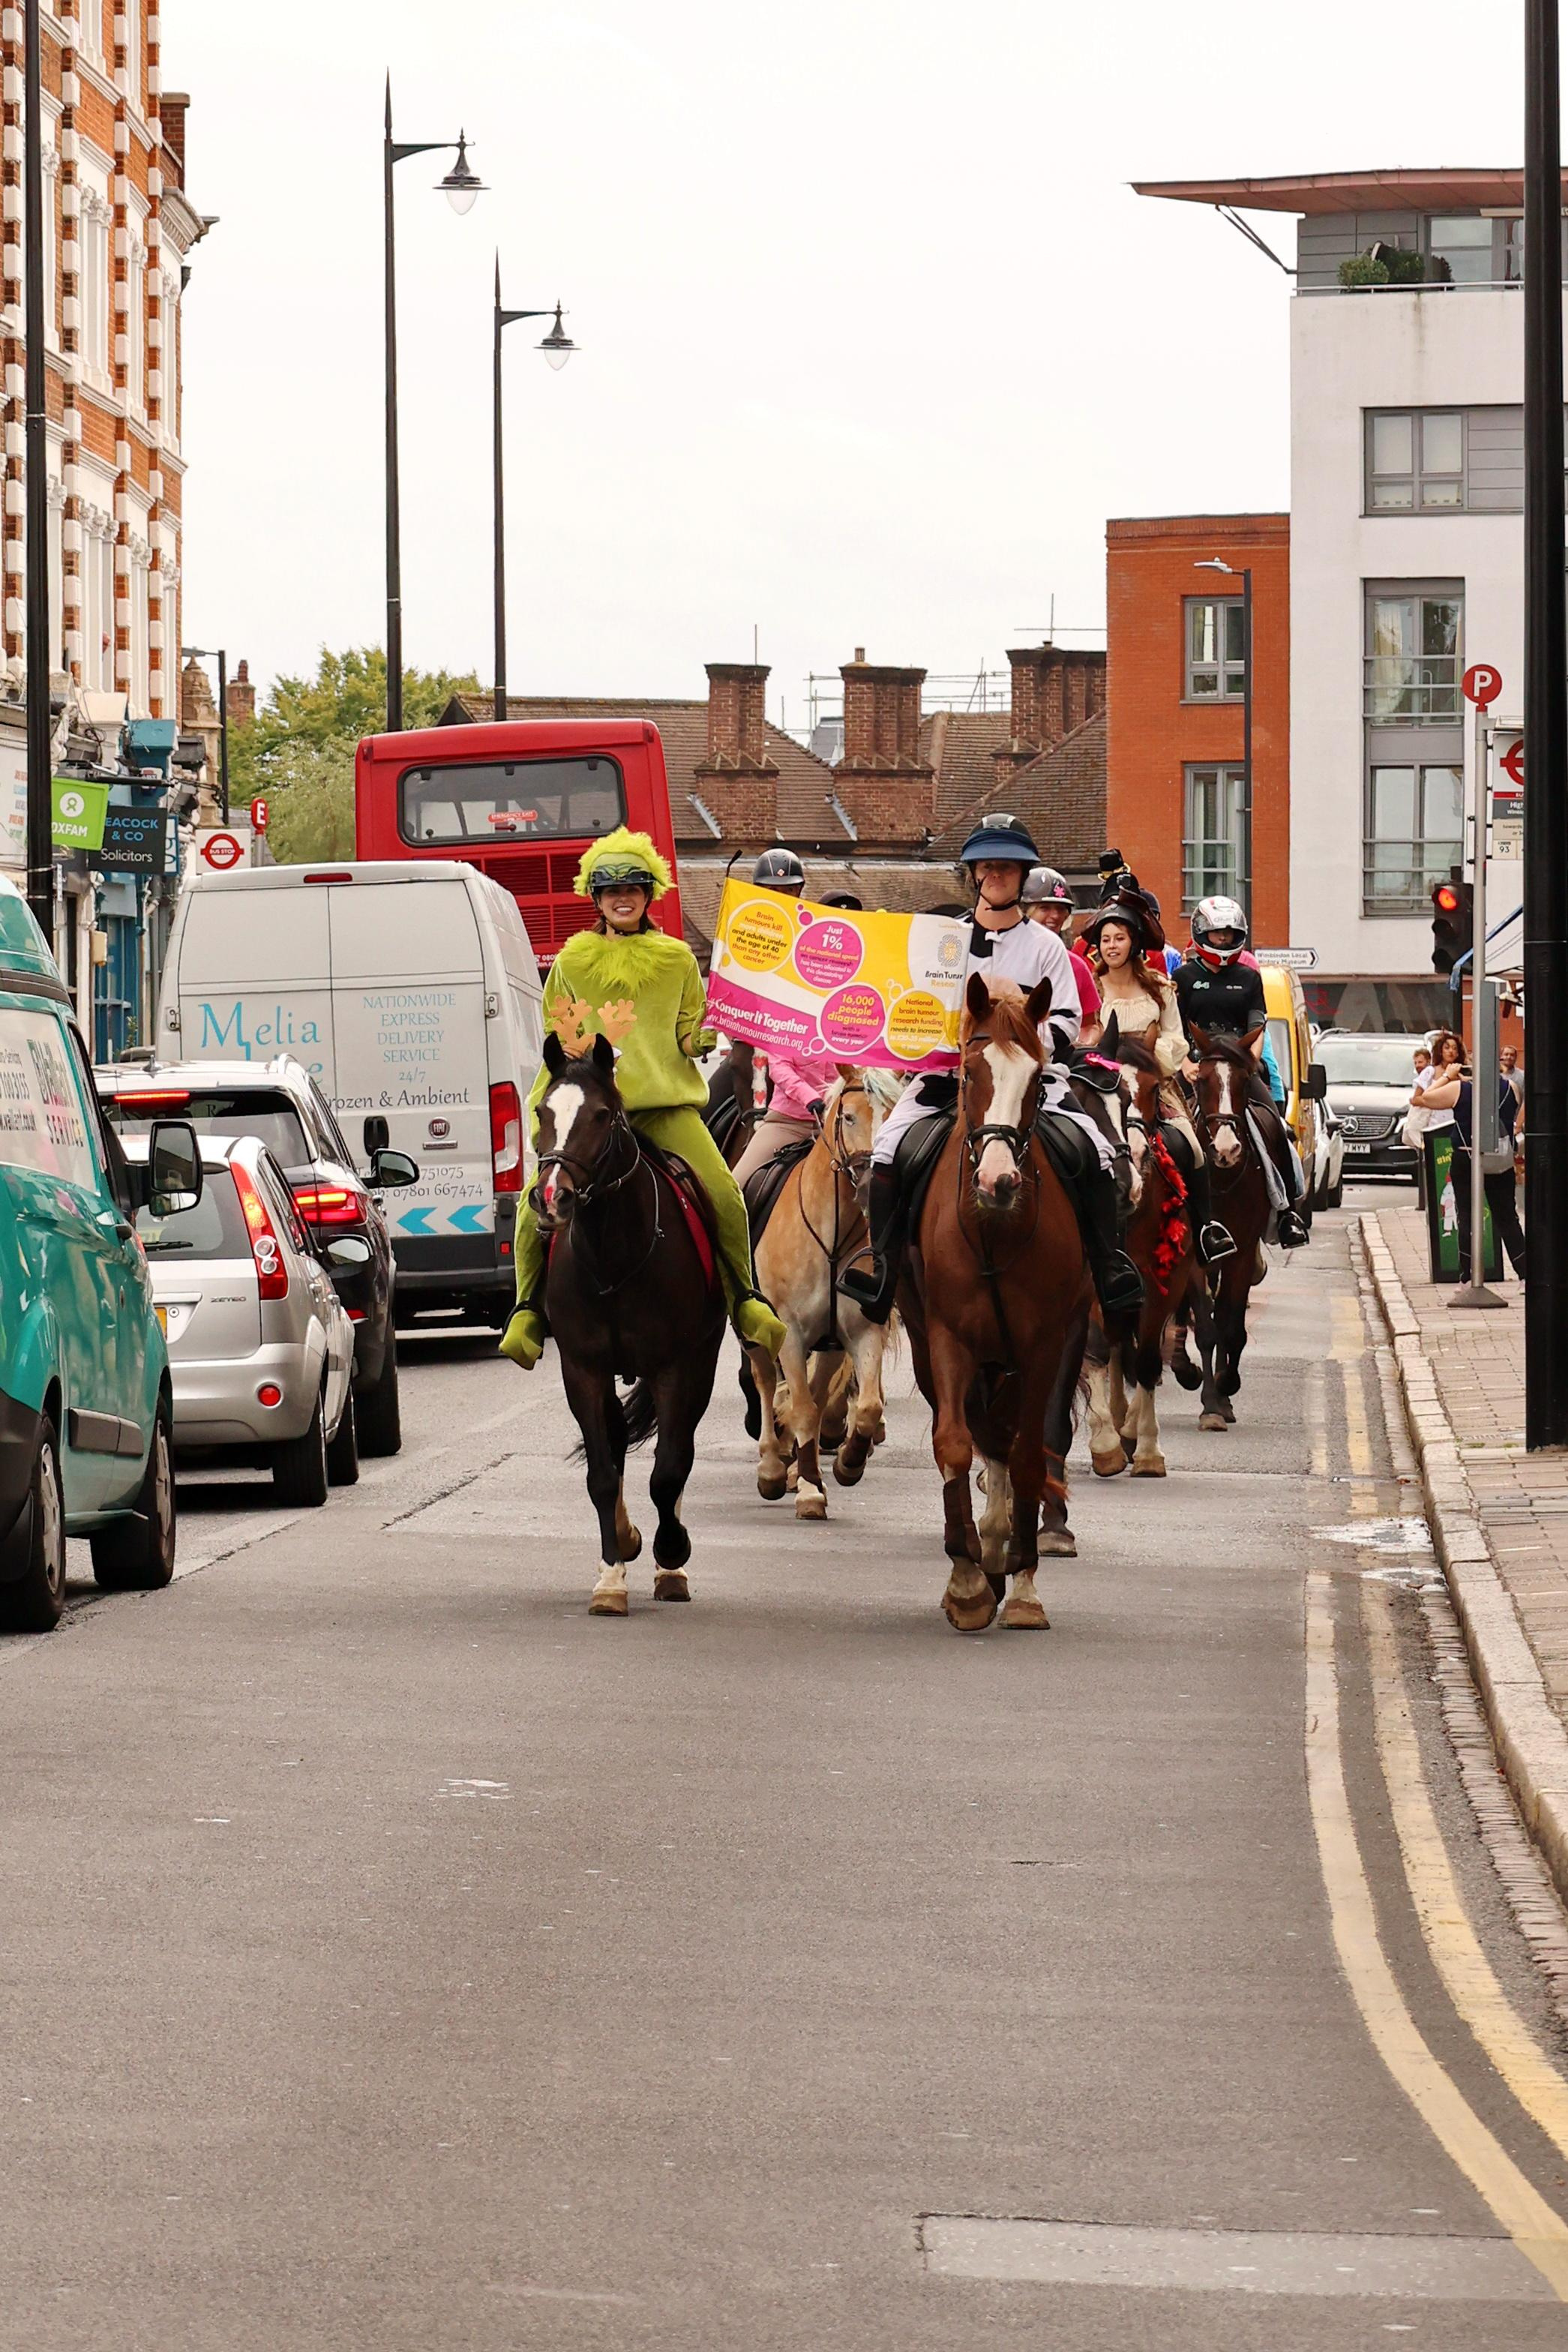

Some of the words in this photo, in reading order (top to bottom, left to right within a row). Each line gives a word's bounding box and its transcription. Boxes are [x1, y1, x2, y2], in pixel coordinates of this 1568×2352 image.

[1474, 670, 1493, 698] P
[256, 802, 266, 825] E
[51, 821, 88, 838] OXFAM
[105, 816, 159, 830] EACOCK
[111, 830, 121, 841] &
[124, 830, 145, 842] CO
[100, 848, 154, 862] Solicitors
[209, 847, 220, 855] BUS
[1498, 845, 1510, 854] 93
[757, 911, 774, 922] Brain
[826, 925, 844, 935] Just
[746, 932, 766, 942] adults
[767, 938, 787, 947] under
[822, 934, 844, 951] 1%
[732, 943, 747, 952] than
[748, 949, 761, 957] any
[762, 952, 780, 961] other
[742, 955, 766, 964] cancer
[925, 970, 944, 979] Brain
[363, 993, 457, 1009] NATIONWIDE
[842, 994, 875, 1006] 16,000
[905, 998, 934, 1006] National
[827, 1010, 880, 1026] diagnosed
[838, 1005, 872, 1017] people
[381, 1012, 440, 1027] EXPRESS
[921, 1017, 943, 1027] funding
[198, 1001, 323, 1054] Melia
[377, 1030, 445, 1045] DELIVERY
[382, 1048, 441, 1064] SERVICE
[398, 1066, 427, 1084] 24/7
[379, 1090, 394, 1108] &
[397, 1086, 470, 1106] Ambient
[433, 1122, 445, 1133] FIAT
[393, 1185, 430, 1200] 07801
[434, 1183, 484, 1199] 667474
